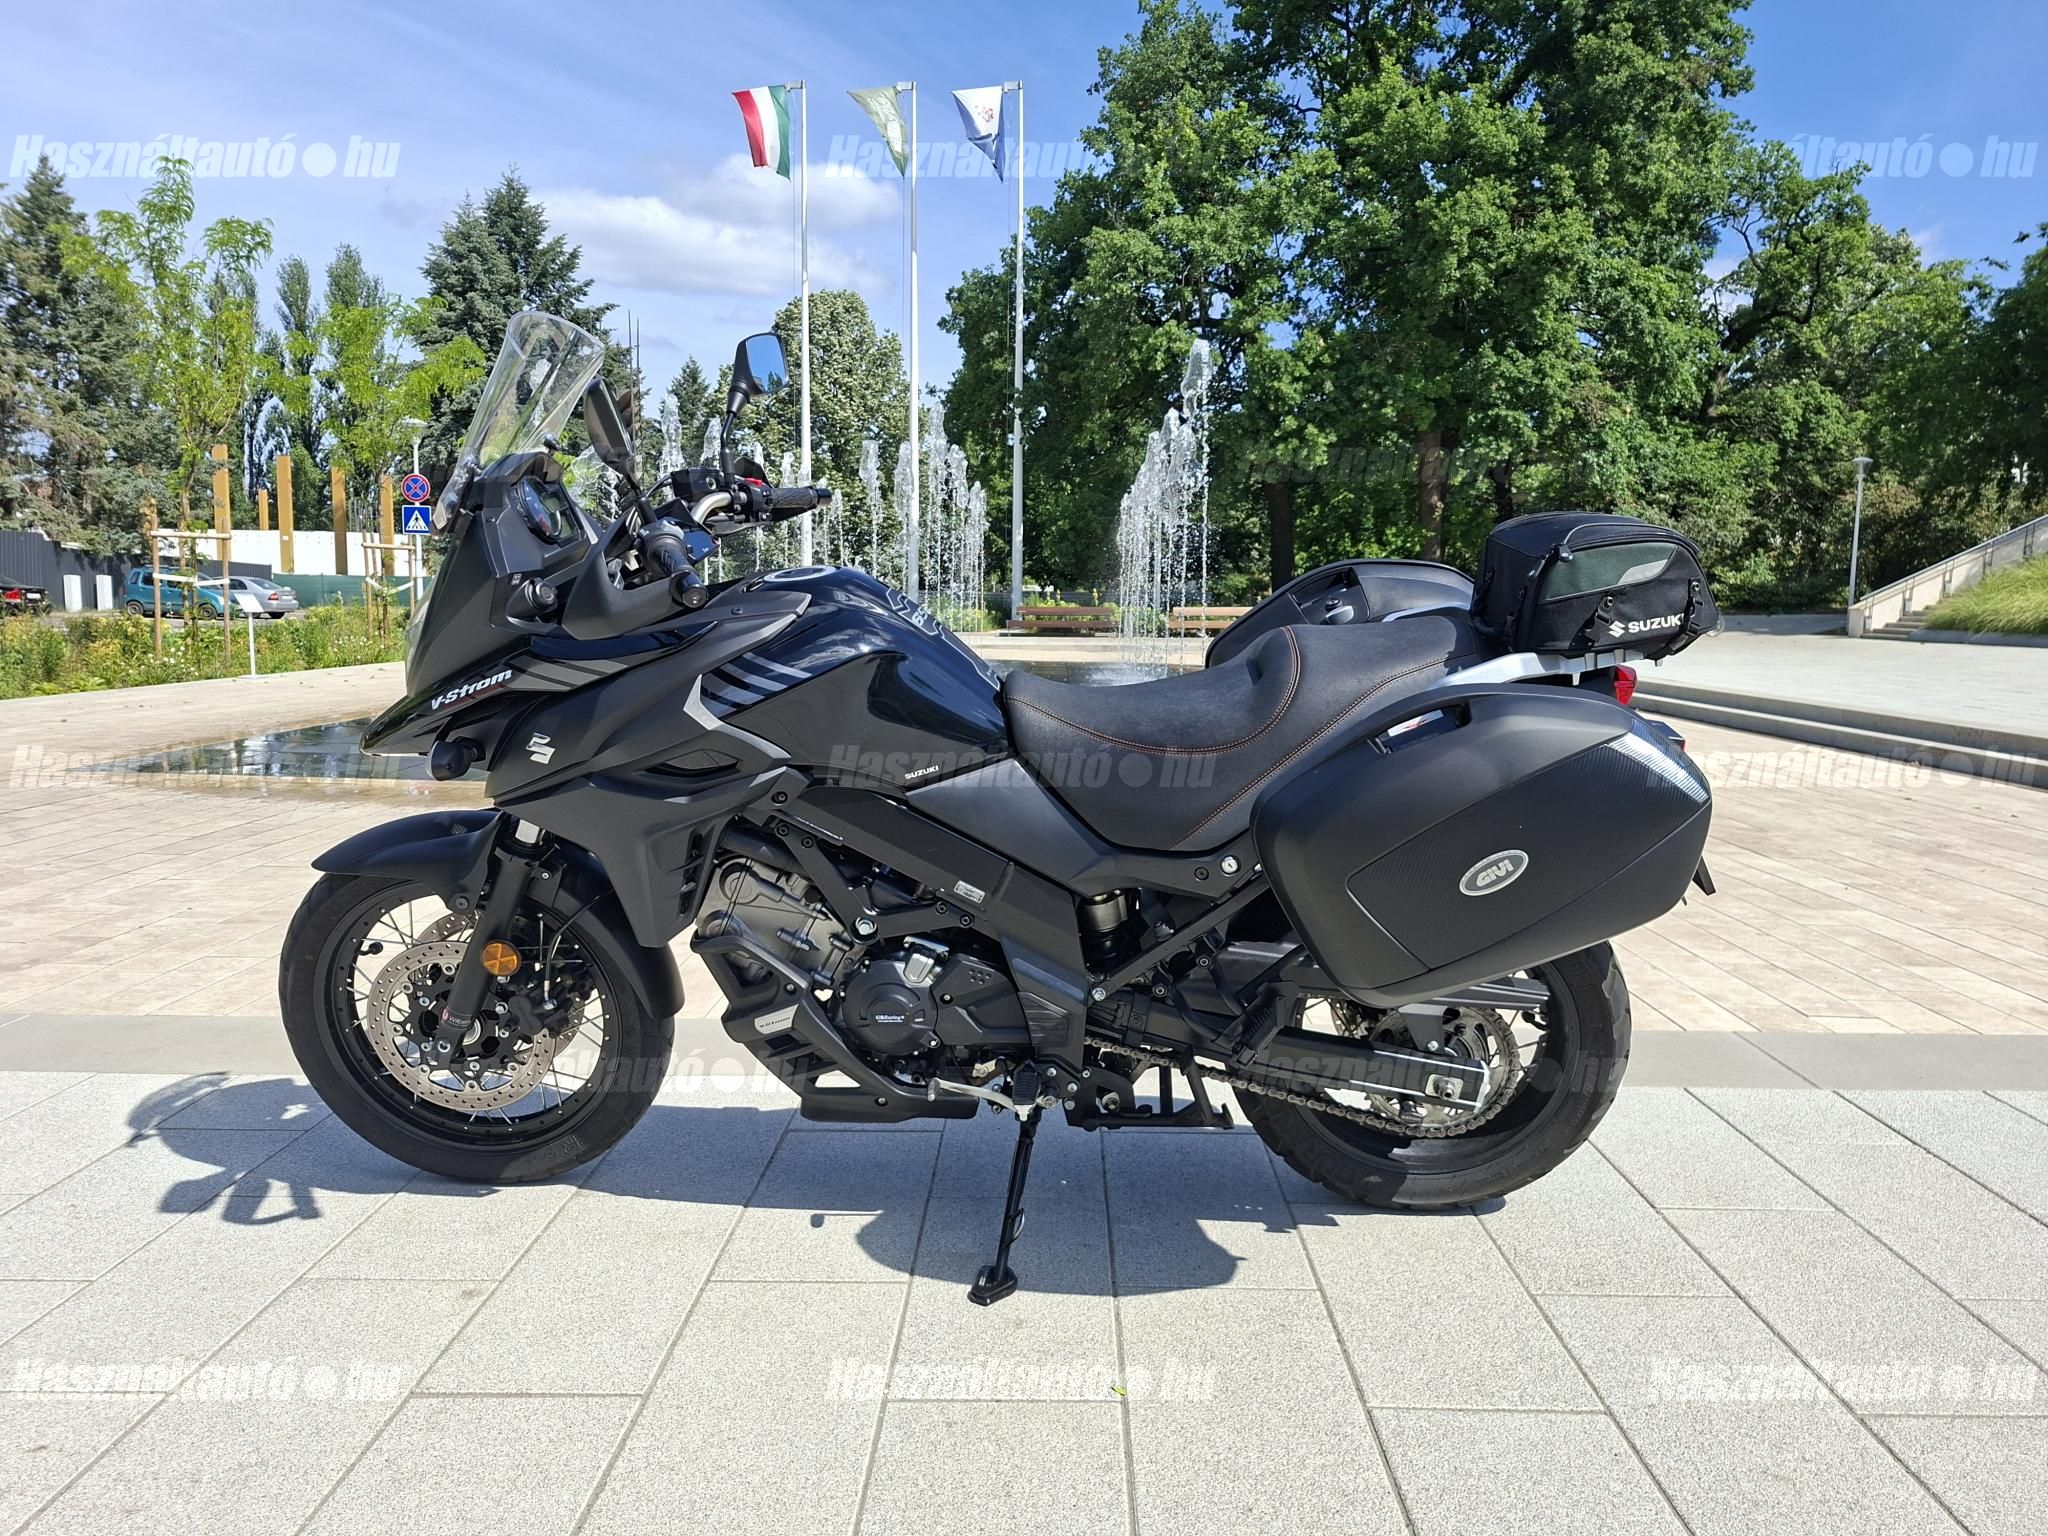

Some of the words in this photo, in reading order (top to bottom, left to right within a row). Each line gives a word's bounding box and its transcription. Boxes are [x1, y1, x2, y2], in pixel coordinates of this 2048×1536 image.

[431, 670, 513, 710] V-Strom
[904, 765, 939, 779] SUZUKI
[1477, 859, 1514, 887] GIVI
